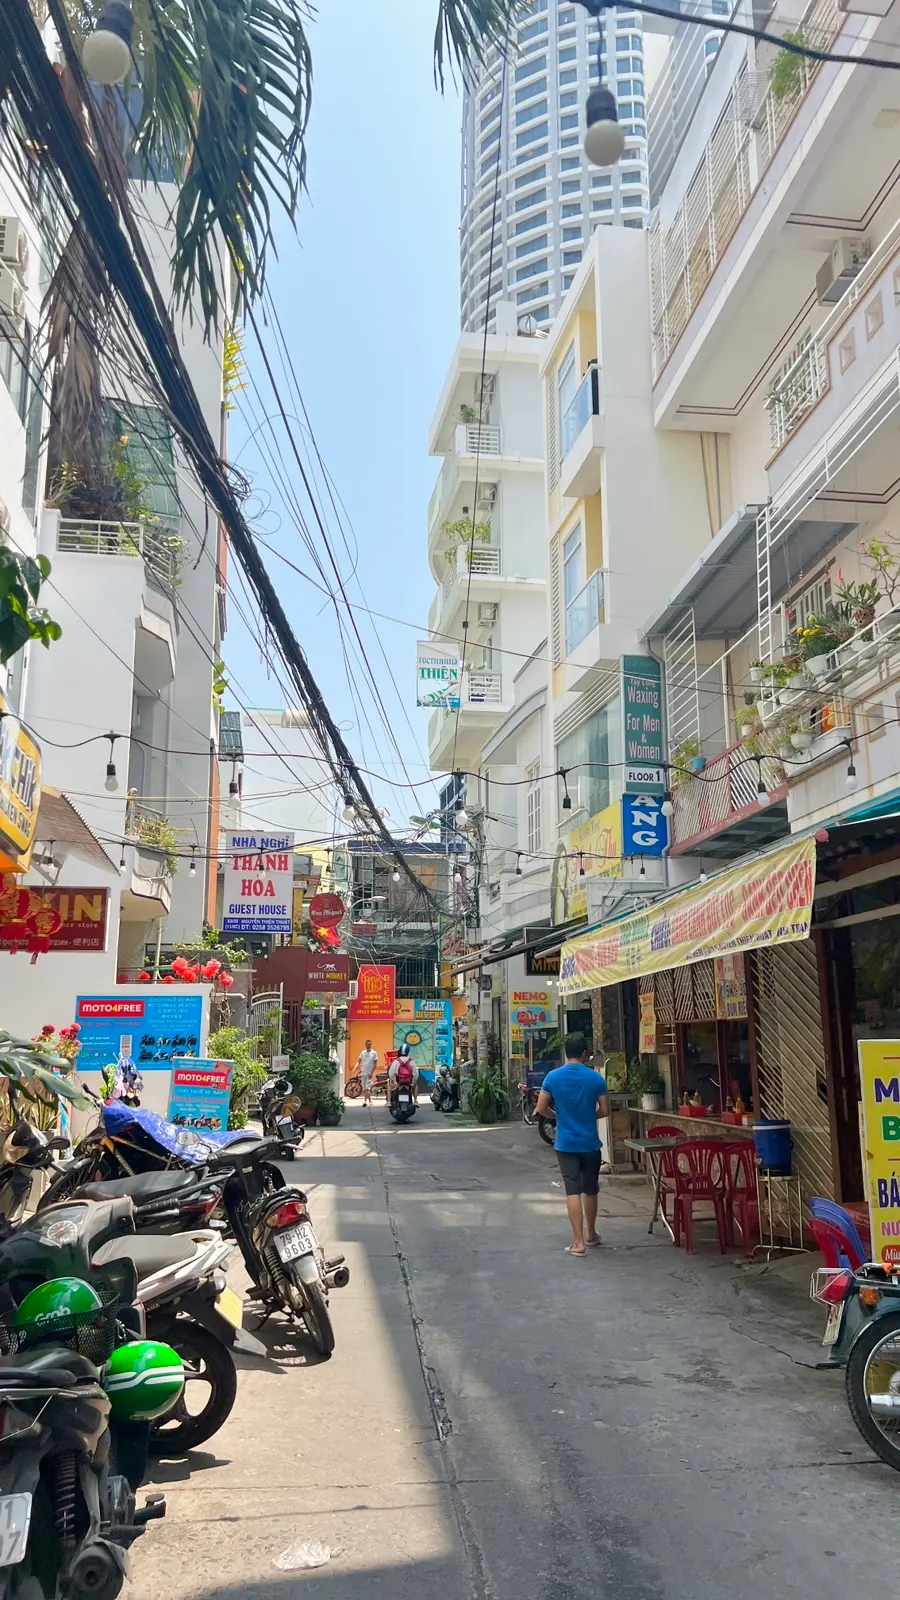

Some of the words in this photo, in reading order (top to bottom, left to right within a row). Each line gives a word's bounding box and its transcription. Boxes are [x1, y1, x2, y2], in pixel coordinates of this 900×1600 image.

[419, 666, 458, 680] THIÊN
[627, 686, 659, 709] Waxing
[627, 713, 640, 731] For
[643, 713, 660, 732] Men
[641, 733, 647, 743] &
[628, 741, 660, 759] Women
[628, 772, 654, 782] FLOOR
[656, 770, 661, 782] 1
[232, 836, 257, 847] NHÀ
[229, 904, 256, 915] GUEST
[259, 904, 287, 915] HOUSE
[73, 938, 100, 946] 便利店
[326, 972, 347, 980] MONKEY
[513, 991, 548, 1001] NEMO
[82, 1004, 142, 1013] MOTO4FREE
[425, 1001, 445, 1011] JELLY
[415, 1011, 445, 1019] DIVERS
[178, 1074, 226, 1083] MOTO4FREE
[280, 1226, 309, 1247] 79-H2
[284, 1239, 313, 1259] 9603
